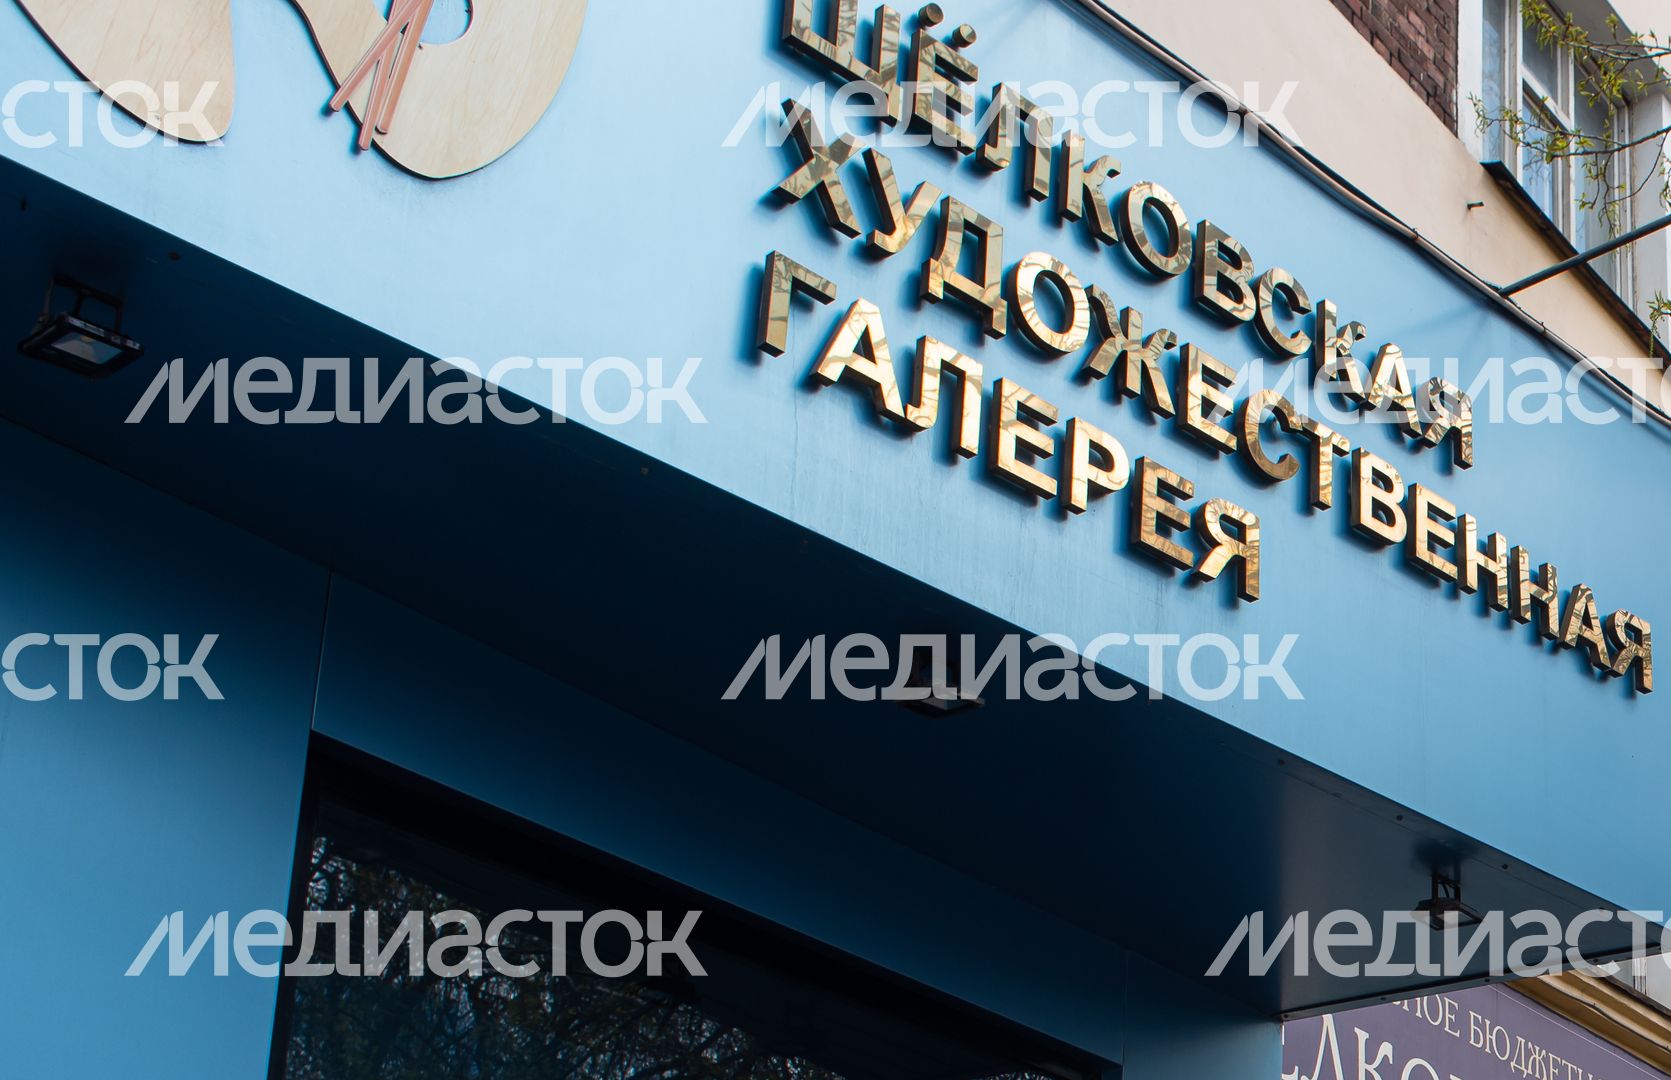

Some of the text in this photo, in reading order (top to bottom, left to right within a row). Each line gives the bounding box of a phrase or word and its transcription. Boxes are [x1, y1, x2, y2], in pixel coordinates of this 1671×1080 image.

[756, 250, 1262, 603] ГАЛЕРЕЯ
[772, 98, 1654, 695] ХУДОЖЕСТВЕННАЯ
[782, 0, 1474, 469] ЩЁЛКОВСКАЯ
